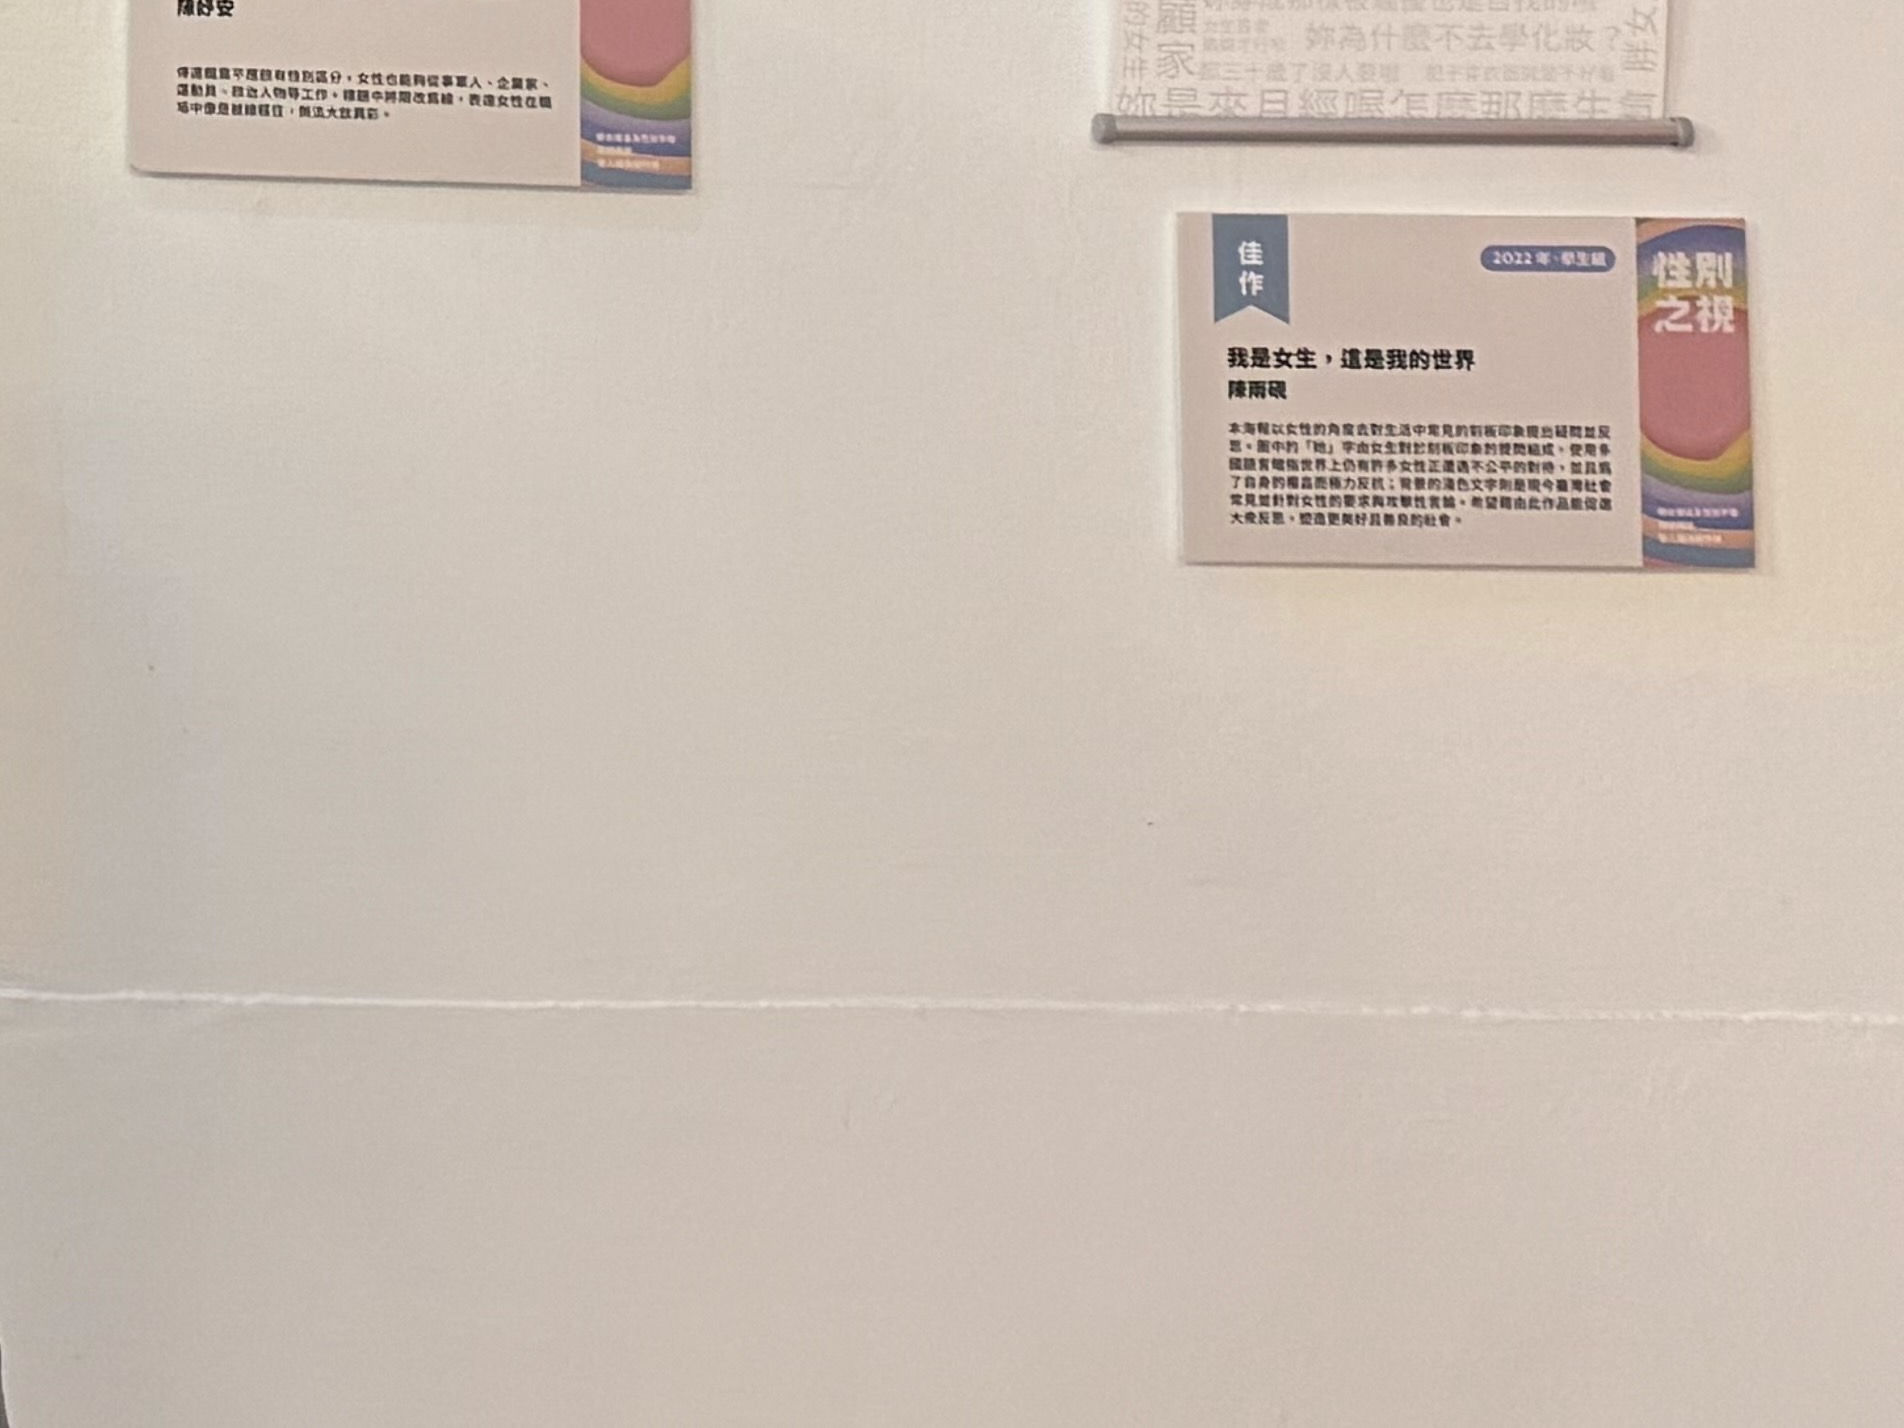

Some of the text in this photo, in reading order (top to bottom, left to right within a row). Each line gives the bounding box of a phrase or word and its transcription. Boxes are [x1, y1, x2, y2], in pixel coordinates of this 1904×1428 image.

[1238, 240, 1264, 296] 佳作
[1652, 250, 1733, 289] 性別
[1653, 295, 1735, 334] 之視
[1227, 347, 1476, 372] 我是女生，這是我的世界
